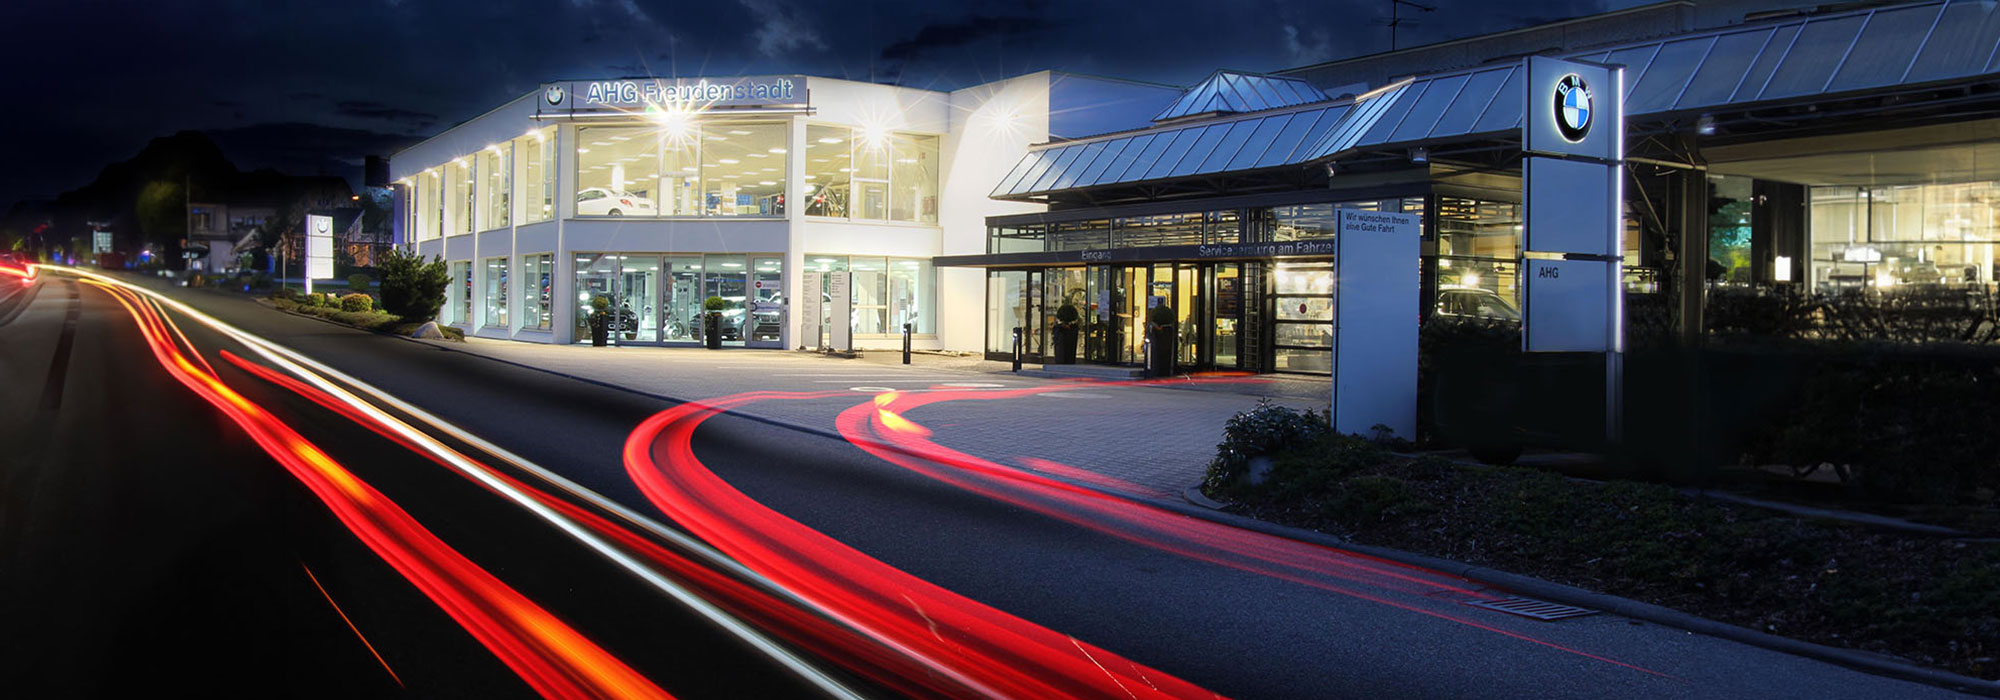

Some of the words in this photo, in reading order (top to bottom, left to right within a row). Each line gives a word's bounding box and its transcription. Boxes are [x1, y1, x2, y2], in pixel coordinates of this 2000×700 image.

[586, 81, 637, 103] AHG
[642, 79, 793, 102] Freudenstadt
[1558, 76, 1592, 99] BMW
[1345, 211, 1357, 220] Wir
[1358, 213, 1391, 224] wünschen
[1391, 216, 1409, 225] Ihnen
[1346, 222, 1360, 231] eine
[1361, 223, 1377, 232] Gute
[1378, 224, 1395, 233] Fahrt
[1278, 244, 1294, 255] am
[1296, 241, 1335, 255] Fahrze
[1539, 266, 1559, 279] AHG
